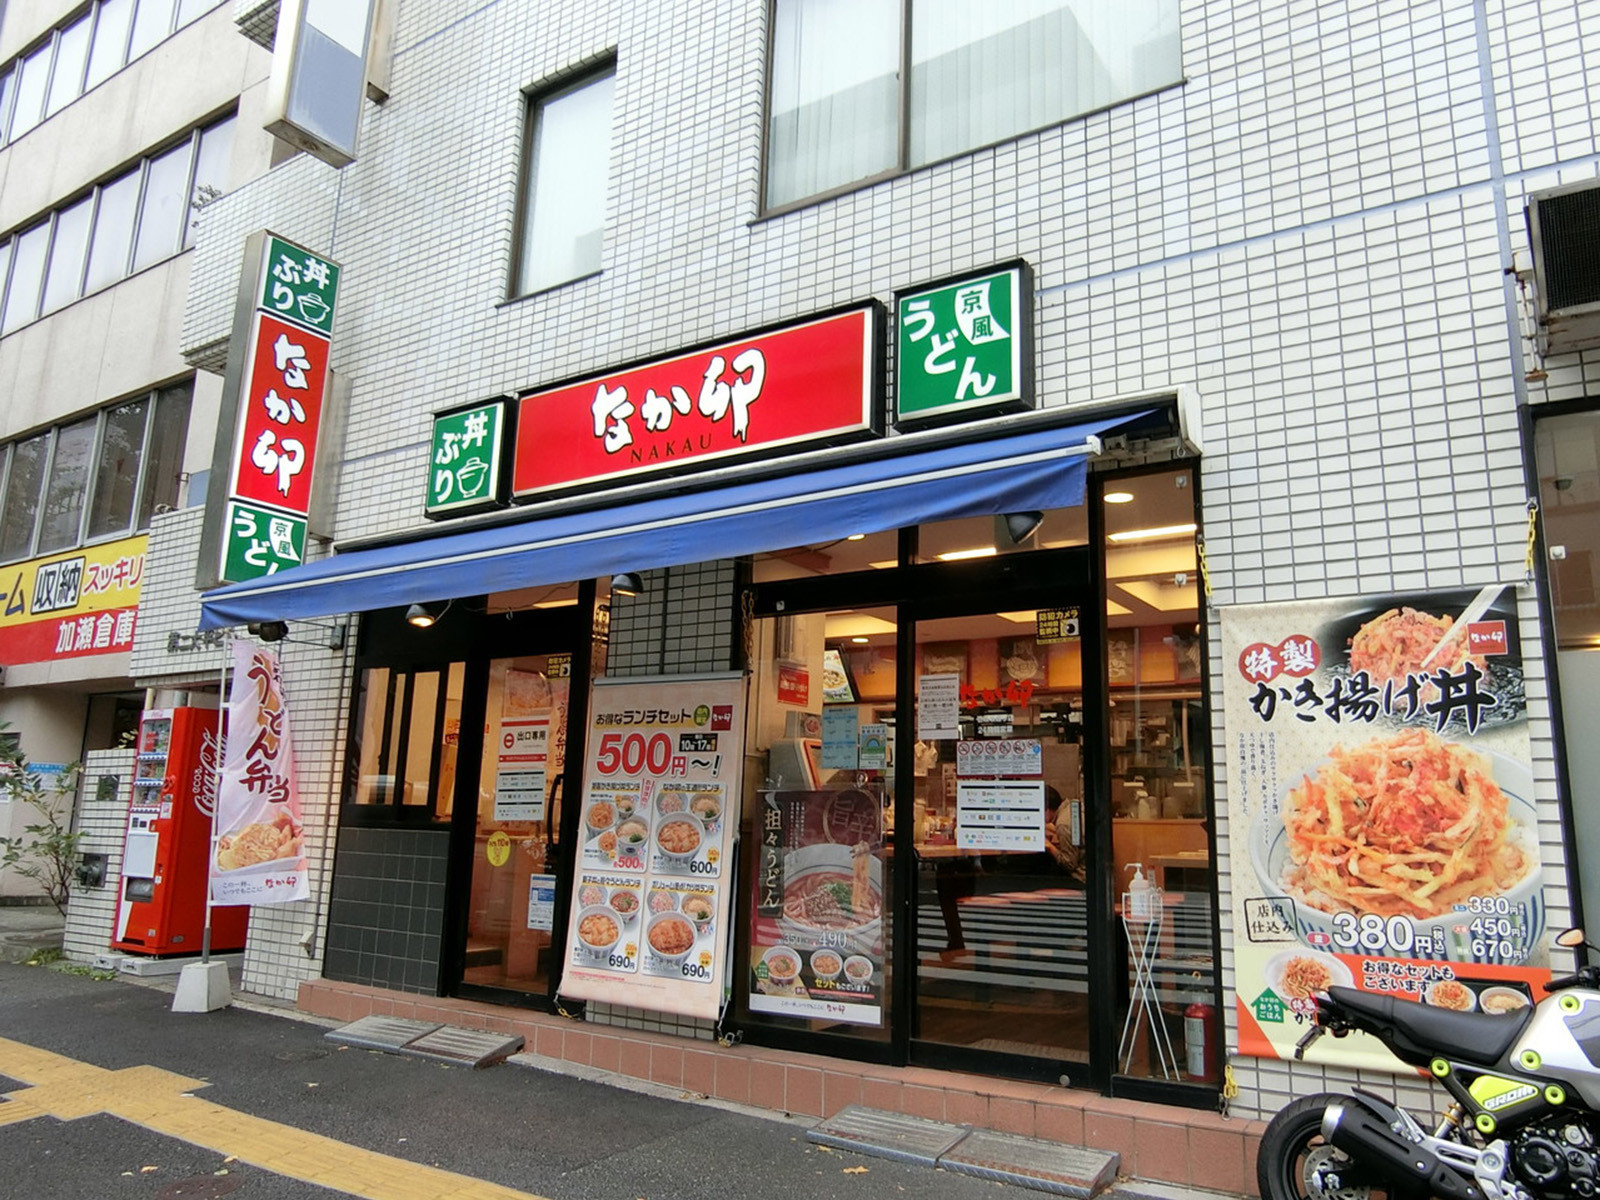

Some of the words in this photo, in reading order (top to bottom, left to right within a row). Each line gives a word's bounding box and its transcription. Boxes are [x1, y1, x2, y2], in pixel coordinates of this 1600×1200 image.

[960, 290, 994, 341] 京風
[903, 300, 997, 401] うどん
[591, 348, 766, 453] なか卯
[251, 333, 312, 498] なか卯
[630, 433, 713, 463] NAKAU
[234, 510, 279, 575] うど
[273, 522, 292, 556] 京風
[83, 556, 144, 594] スッキリ
[55, 611, 138, 653] 加瀬倉庫
[1471, 631, 1503, 646] なか卯
[1244, 639, 1316, 679] 特製
[960, 680, 1034, 709] なか卯
[1249, 661, 1497, 735] かき揚げ丼
[596, 708, 692, 726] お得なランチセット
[239, 654, 290, 803] うどん弁当
[517, 731, 546, 741] 出口専用
[690, 860, 718, 875] 600円
[266, 876, 297, 889] なか卯
[1257, 904, 1285, 918] 店内
[1469, 896, 1518, 915] 330円
[1251, 921, 1295, 935] 仕込み
[1333, 912, 1432, 953] 380円
[1470, 918, 1520, 938] 450円
[1472, 939, 1522, 960] 670円
[608, 954, 635, 969] 690円
[682, 964, 710, 979] 690円
[1363, 961, 1455, 980] お得なセットも
[1363, 976, 1431, 992] ございます
[1259, 1003, 1280, 1012] おうち
[1259, 1011, 1281, 1020] ごはん
[1485, 1085, 1534, 1110] GROM
